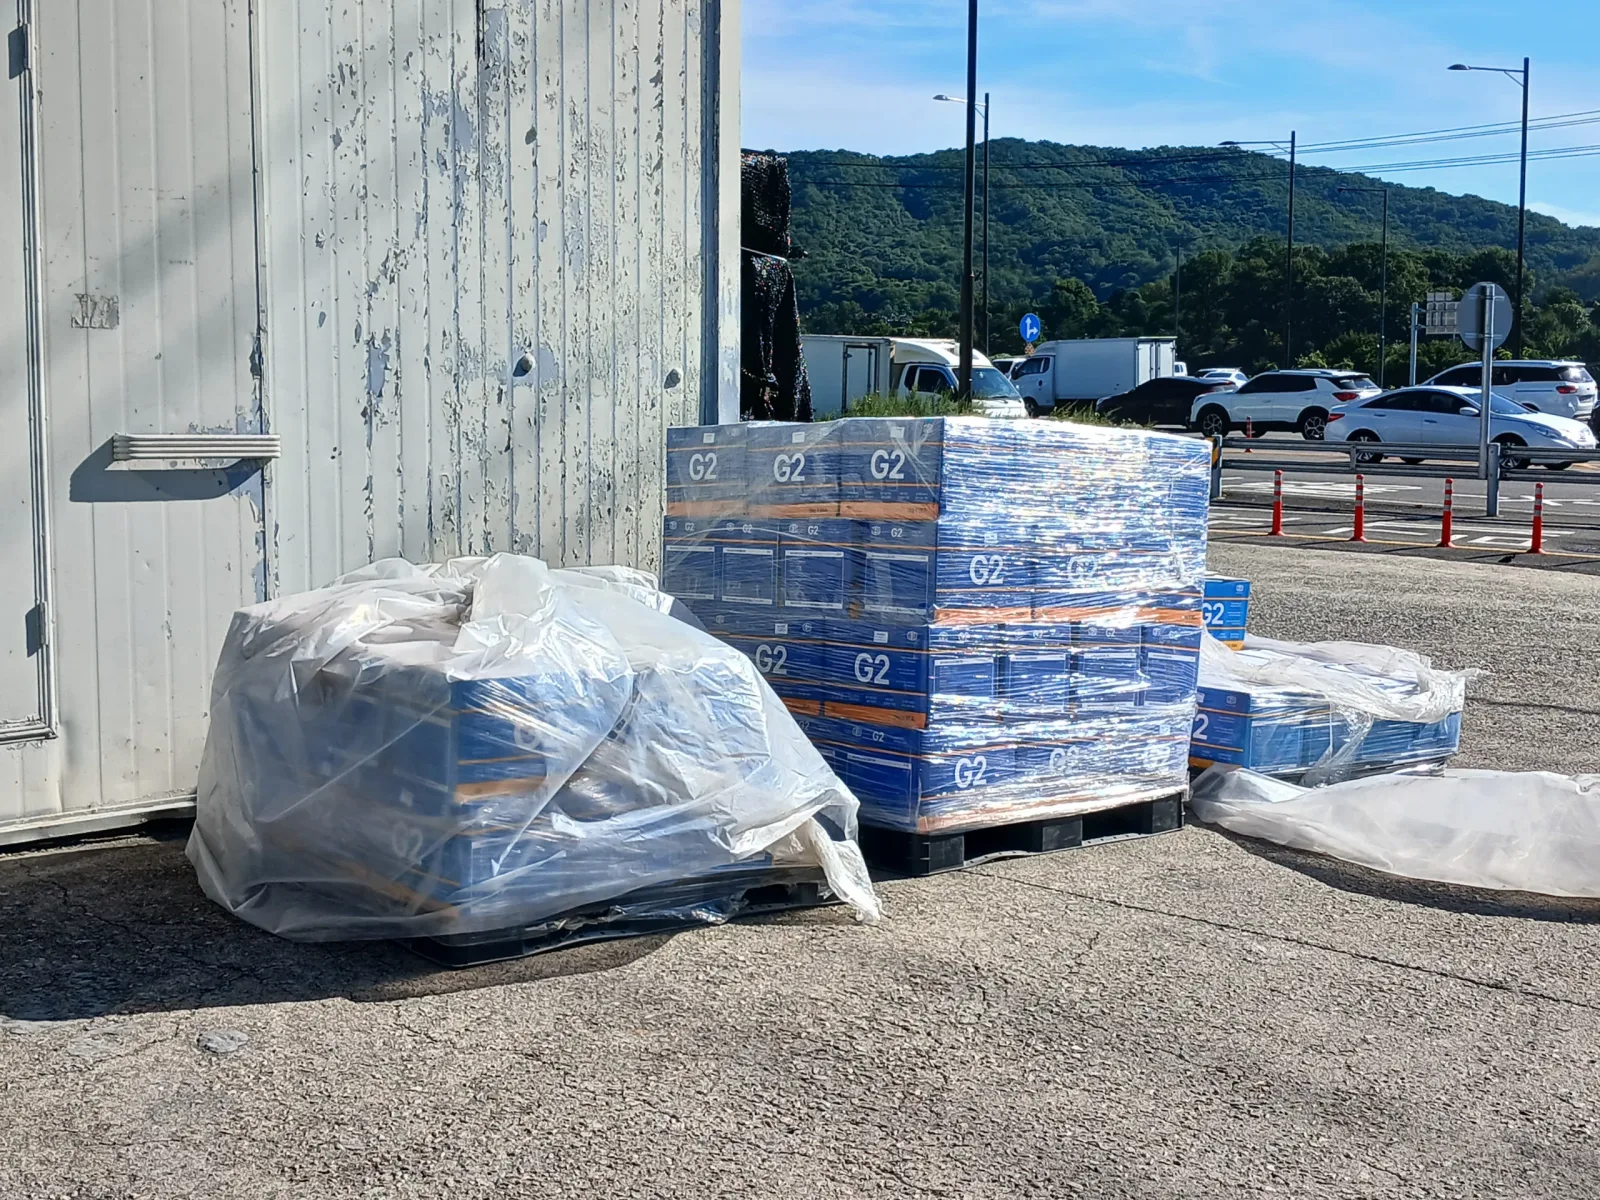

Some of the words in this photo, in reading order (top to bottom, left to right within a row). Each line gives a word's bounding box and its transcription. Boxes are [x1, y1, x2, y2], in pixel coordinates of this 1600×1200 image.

[689, 452, 717, 480] G2
[773, 452, 806, 482] G2
[870, 449, 905, 480] G2
[807, 525, 819, 535] G2
[890, 528, 903, 538] G2
[969, 554, 1004, 585] G2
[1202, 602, 1225, 625] G2
[755, 644, 788, 675] G2
[854, 652, 891, 685] G2
[872, 731, 885, 743] G2
[953, 755, 988, 788] G2
